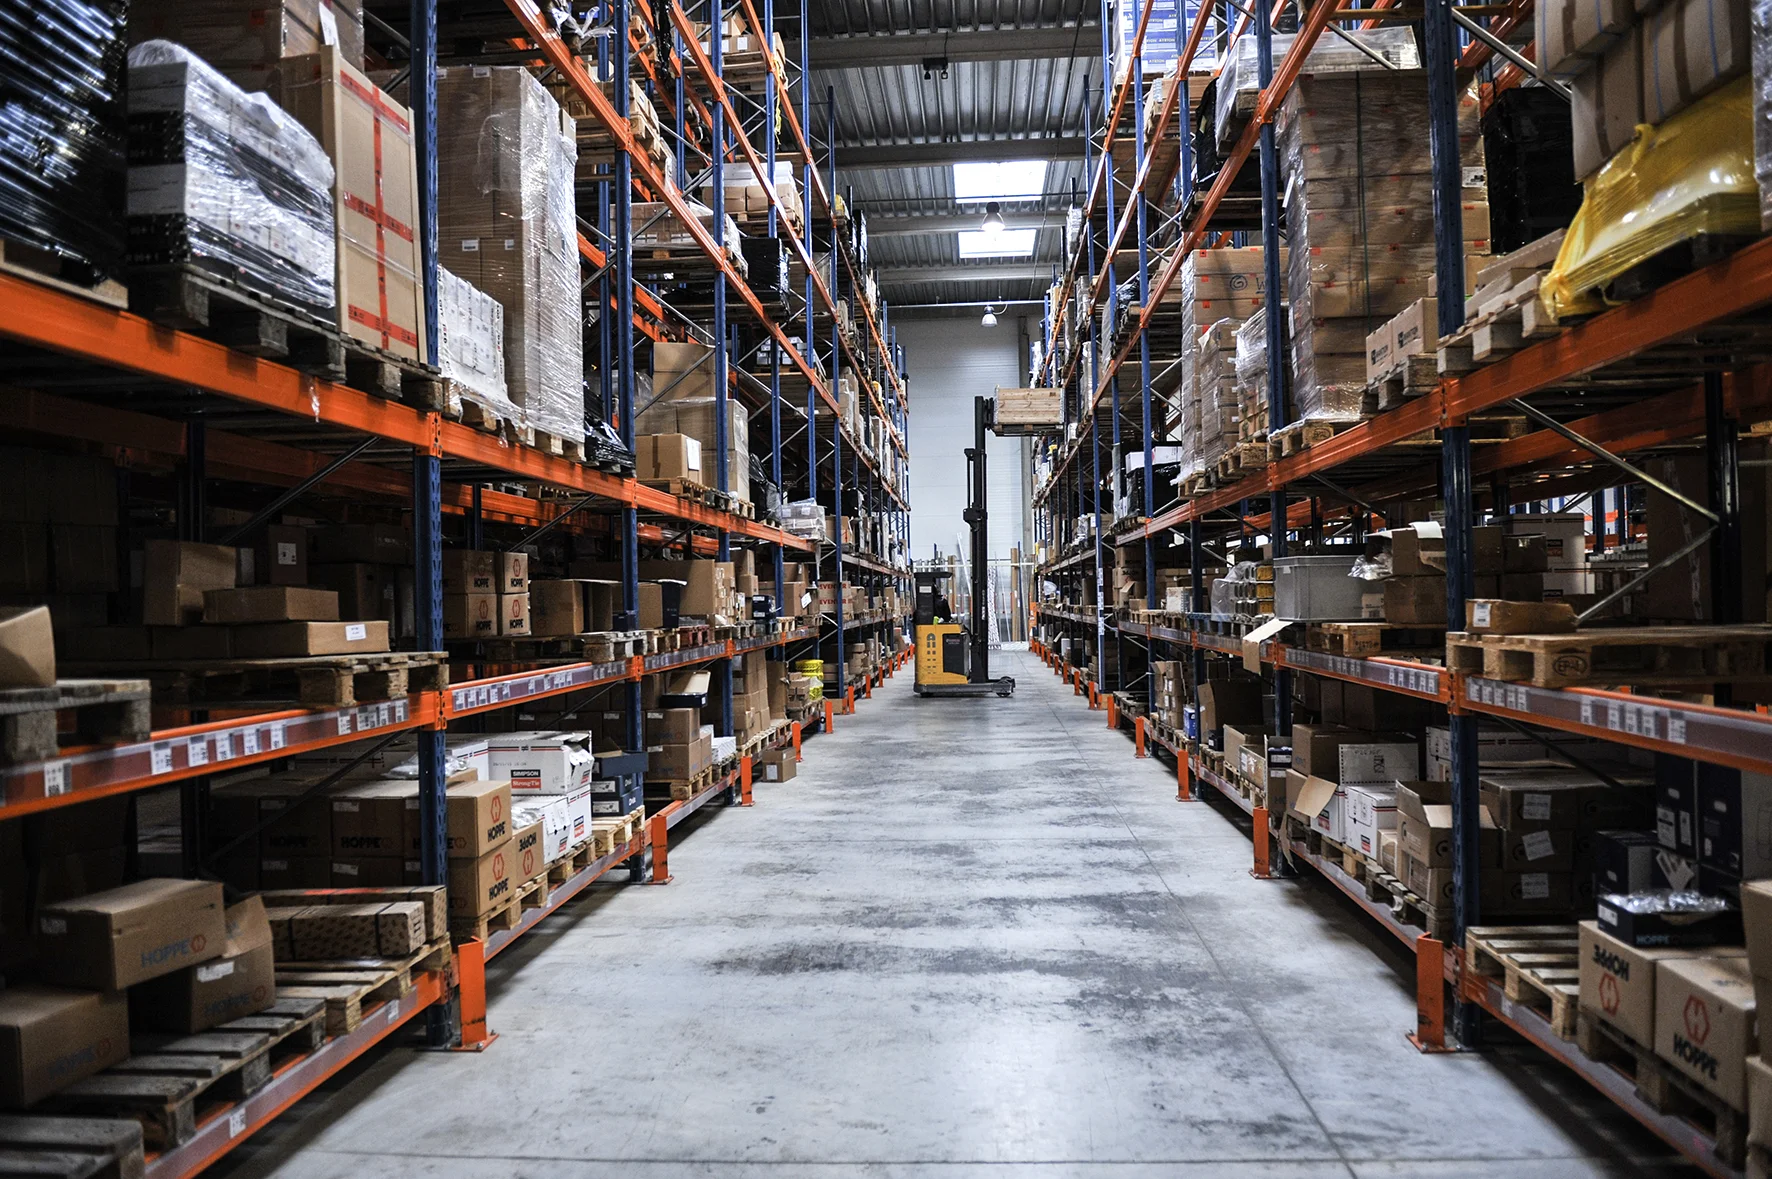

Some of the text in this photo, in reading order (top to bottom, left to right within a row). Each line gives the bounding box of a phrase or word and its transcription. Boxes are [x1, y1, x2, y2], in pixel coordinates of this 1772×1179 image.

[474, 577, 489, 588] HOPPE
[511, 577, 524, 588] HOPPE
[476, 620, 492, 632] HOPPE
[510, 618, 524, 630] HOPPE
[487, 821, 506, 843] HOPPE
[341, 836, 382, 849] HOPPE
[519, 831, 538, 853] HOPPE
[488, 877, 510, 902] HOPPE
[1635, 934, 1671, 946] HOPPE
[140, 938, 189, 968] HOPPE
[1593, 944, 1630, 983] HOPPE
[1673, 1031, 1719, 1082] HOPPE
